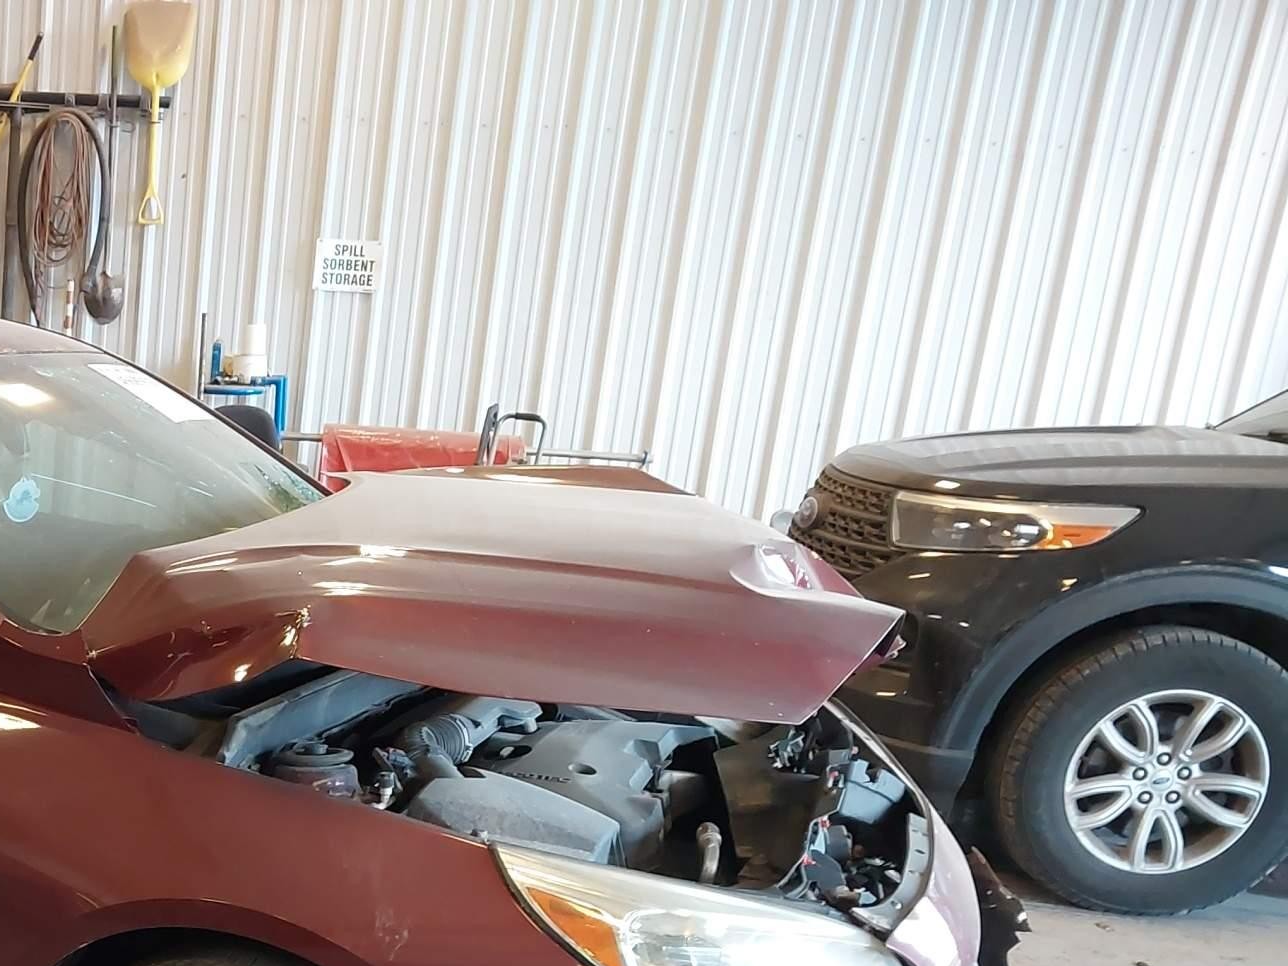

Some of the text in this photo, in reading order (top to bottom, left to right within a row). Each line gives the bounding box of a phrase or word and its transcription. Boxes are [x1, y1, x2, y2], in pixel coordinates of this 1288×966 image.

[334, 244, 365, 257] SPILL
[323, 258, 376, 272] SORBENT
[321, 272, 373, 286] STORAGE
